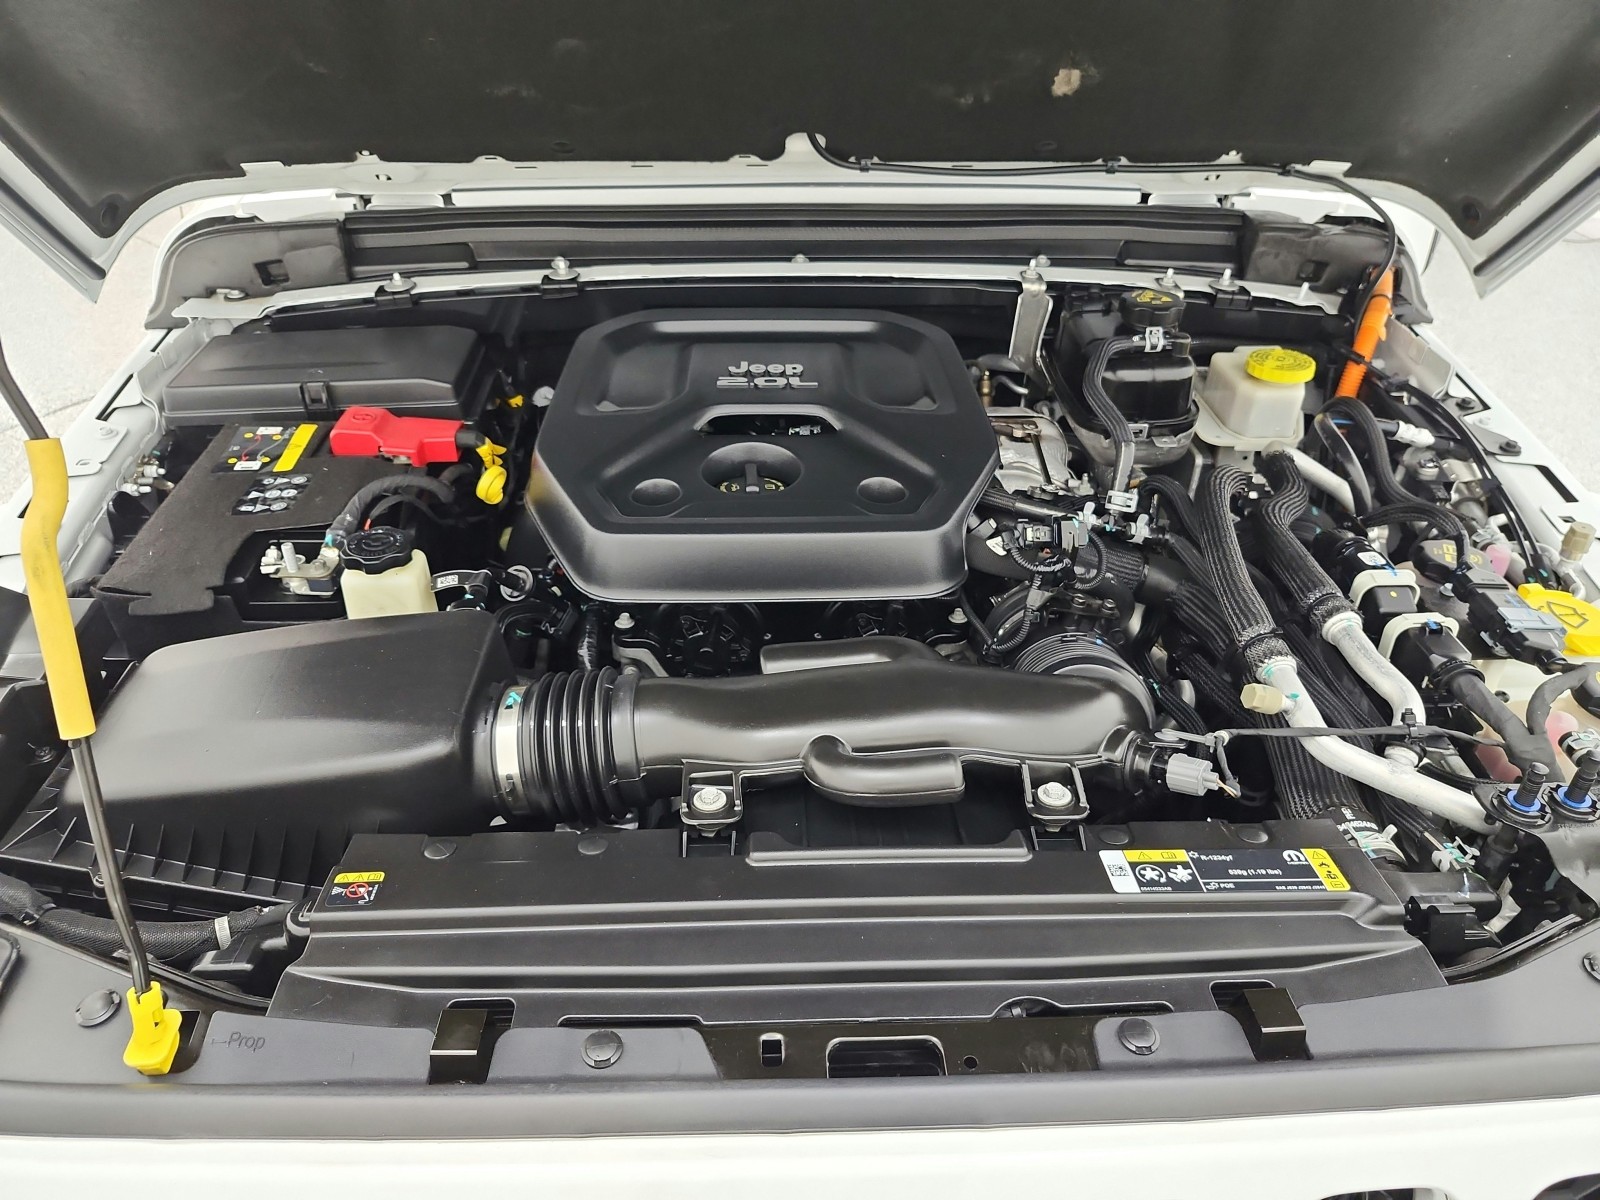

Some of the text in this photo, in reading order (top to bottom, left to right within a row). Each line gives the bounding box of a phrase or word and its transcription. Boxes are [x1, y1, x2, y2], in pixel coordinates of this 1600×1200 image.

[728, 361, 803, 376] Jeep
[717, 377, 818, 388] 2.0L
[227, 1032, 265, 1053] Prop
